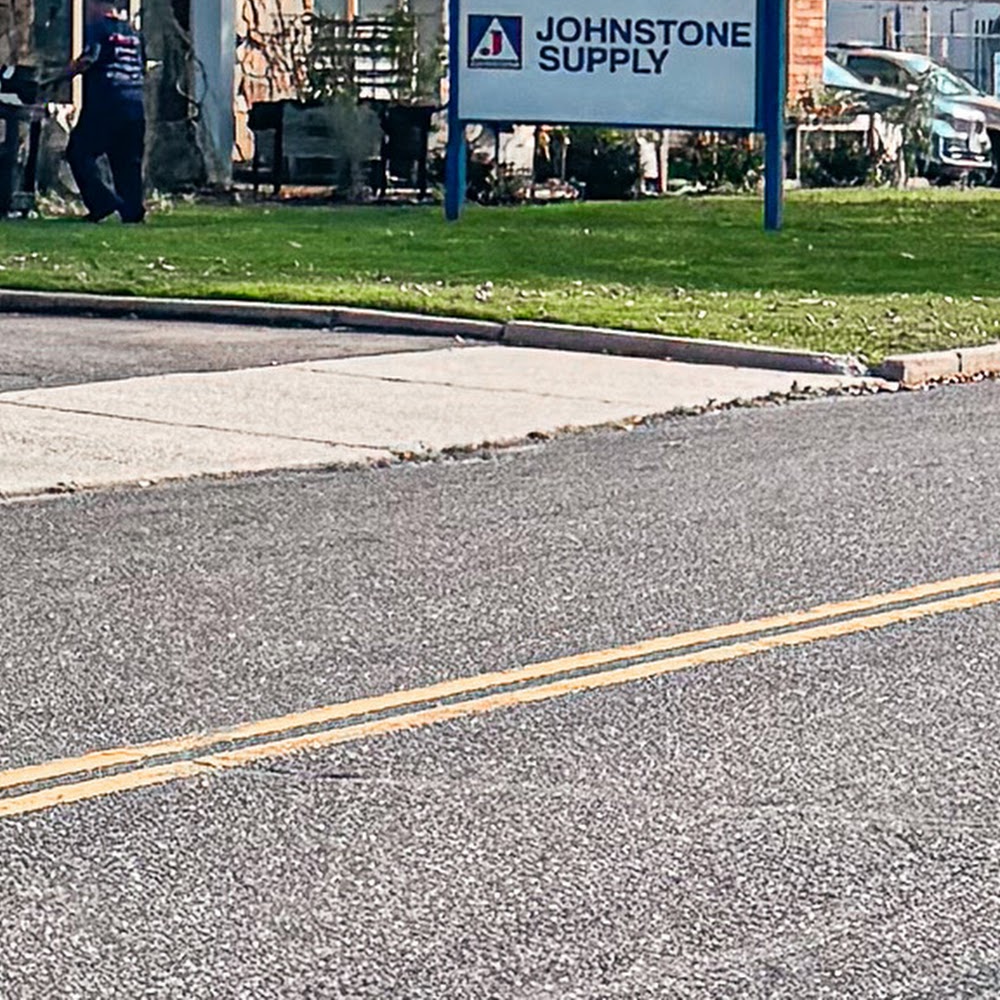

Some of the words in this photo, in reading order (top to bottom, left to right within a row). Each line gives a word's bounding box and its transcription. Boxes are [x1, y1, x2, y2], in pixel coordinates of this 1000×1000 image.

[479, 30, 503, 56] J
[536, 16, 752, 47] JOHNSTONE
[538, 45, 668, 74] SUPPLY
